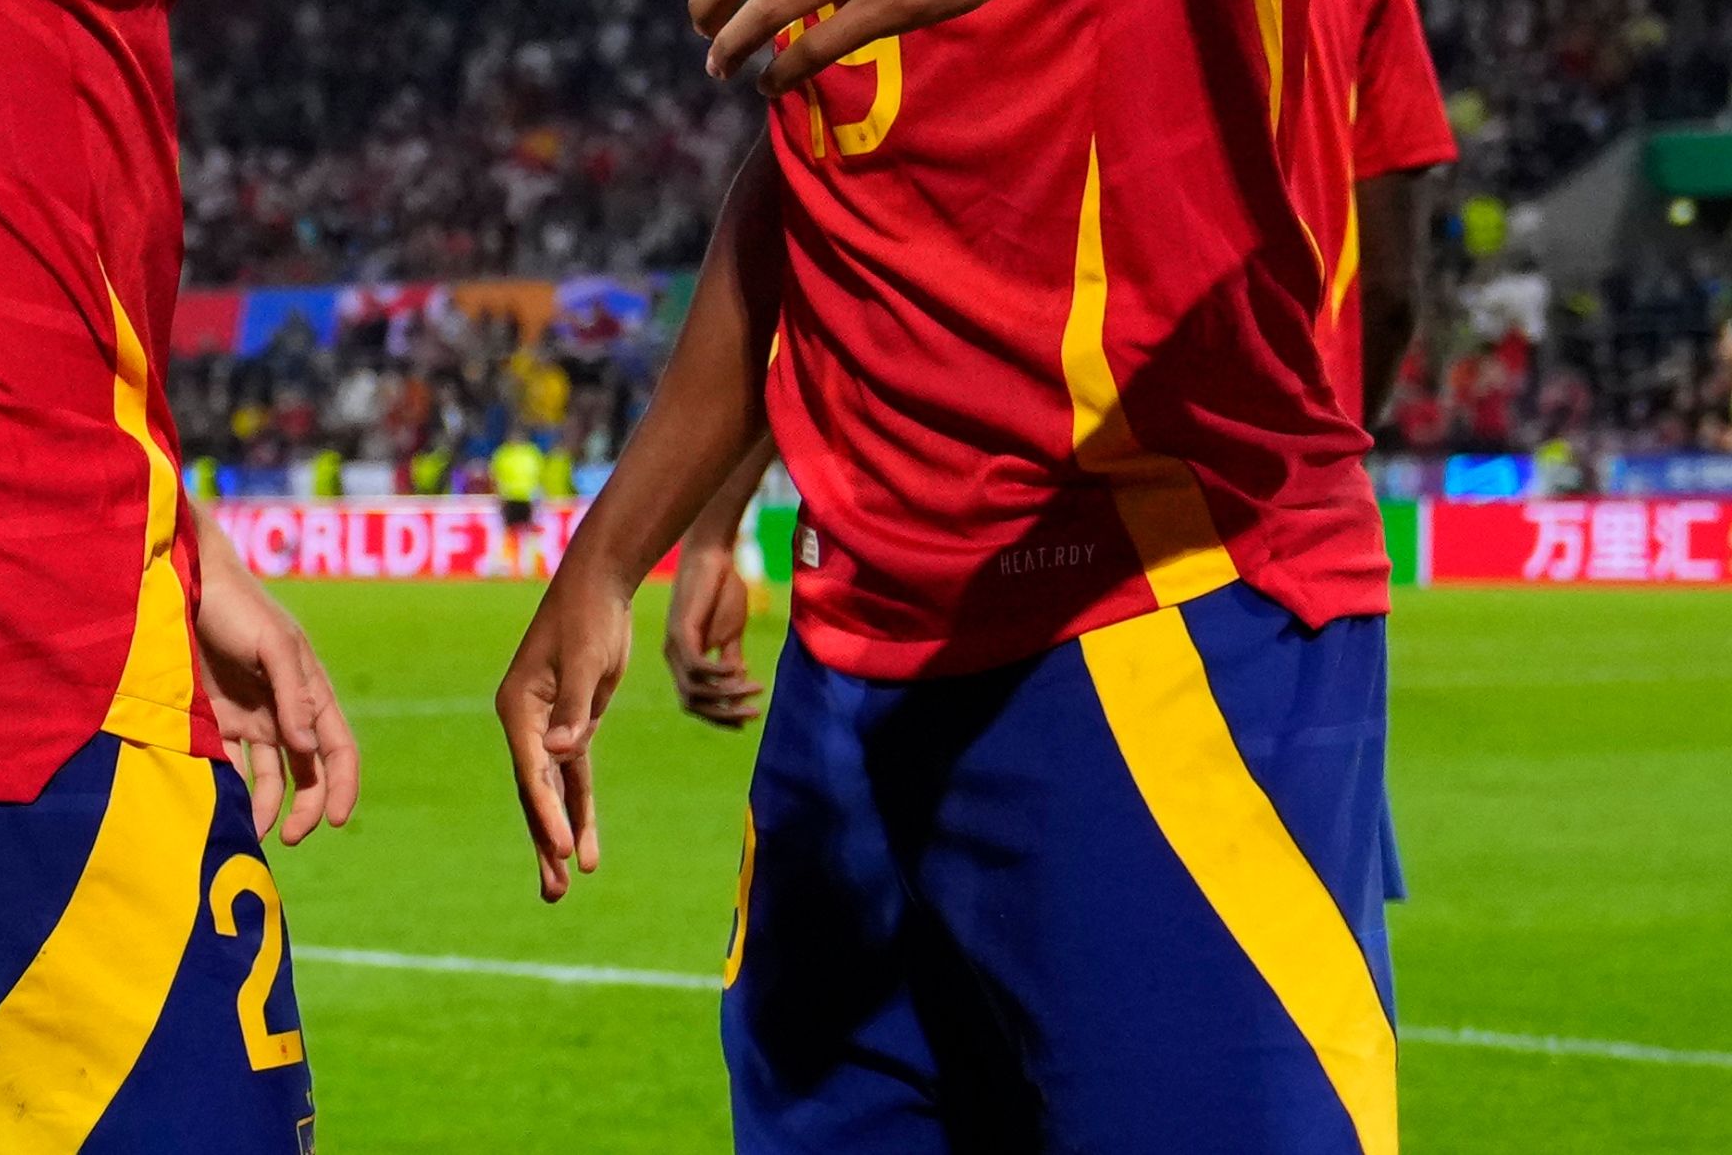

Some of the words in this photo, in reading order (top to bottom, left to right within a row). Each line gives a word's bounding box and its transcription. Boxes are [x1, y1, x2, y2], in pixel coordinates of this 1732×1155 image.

[999, 543, 1096, 576] HEAT.RDY
[1522, 501, 1719, 581] 万里汇
[208, 852, 304, 1071] 2
